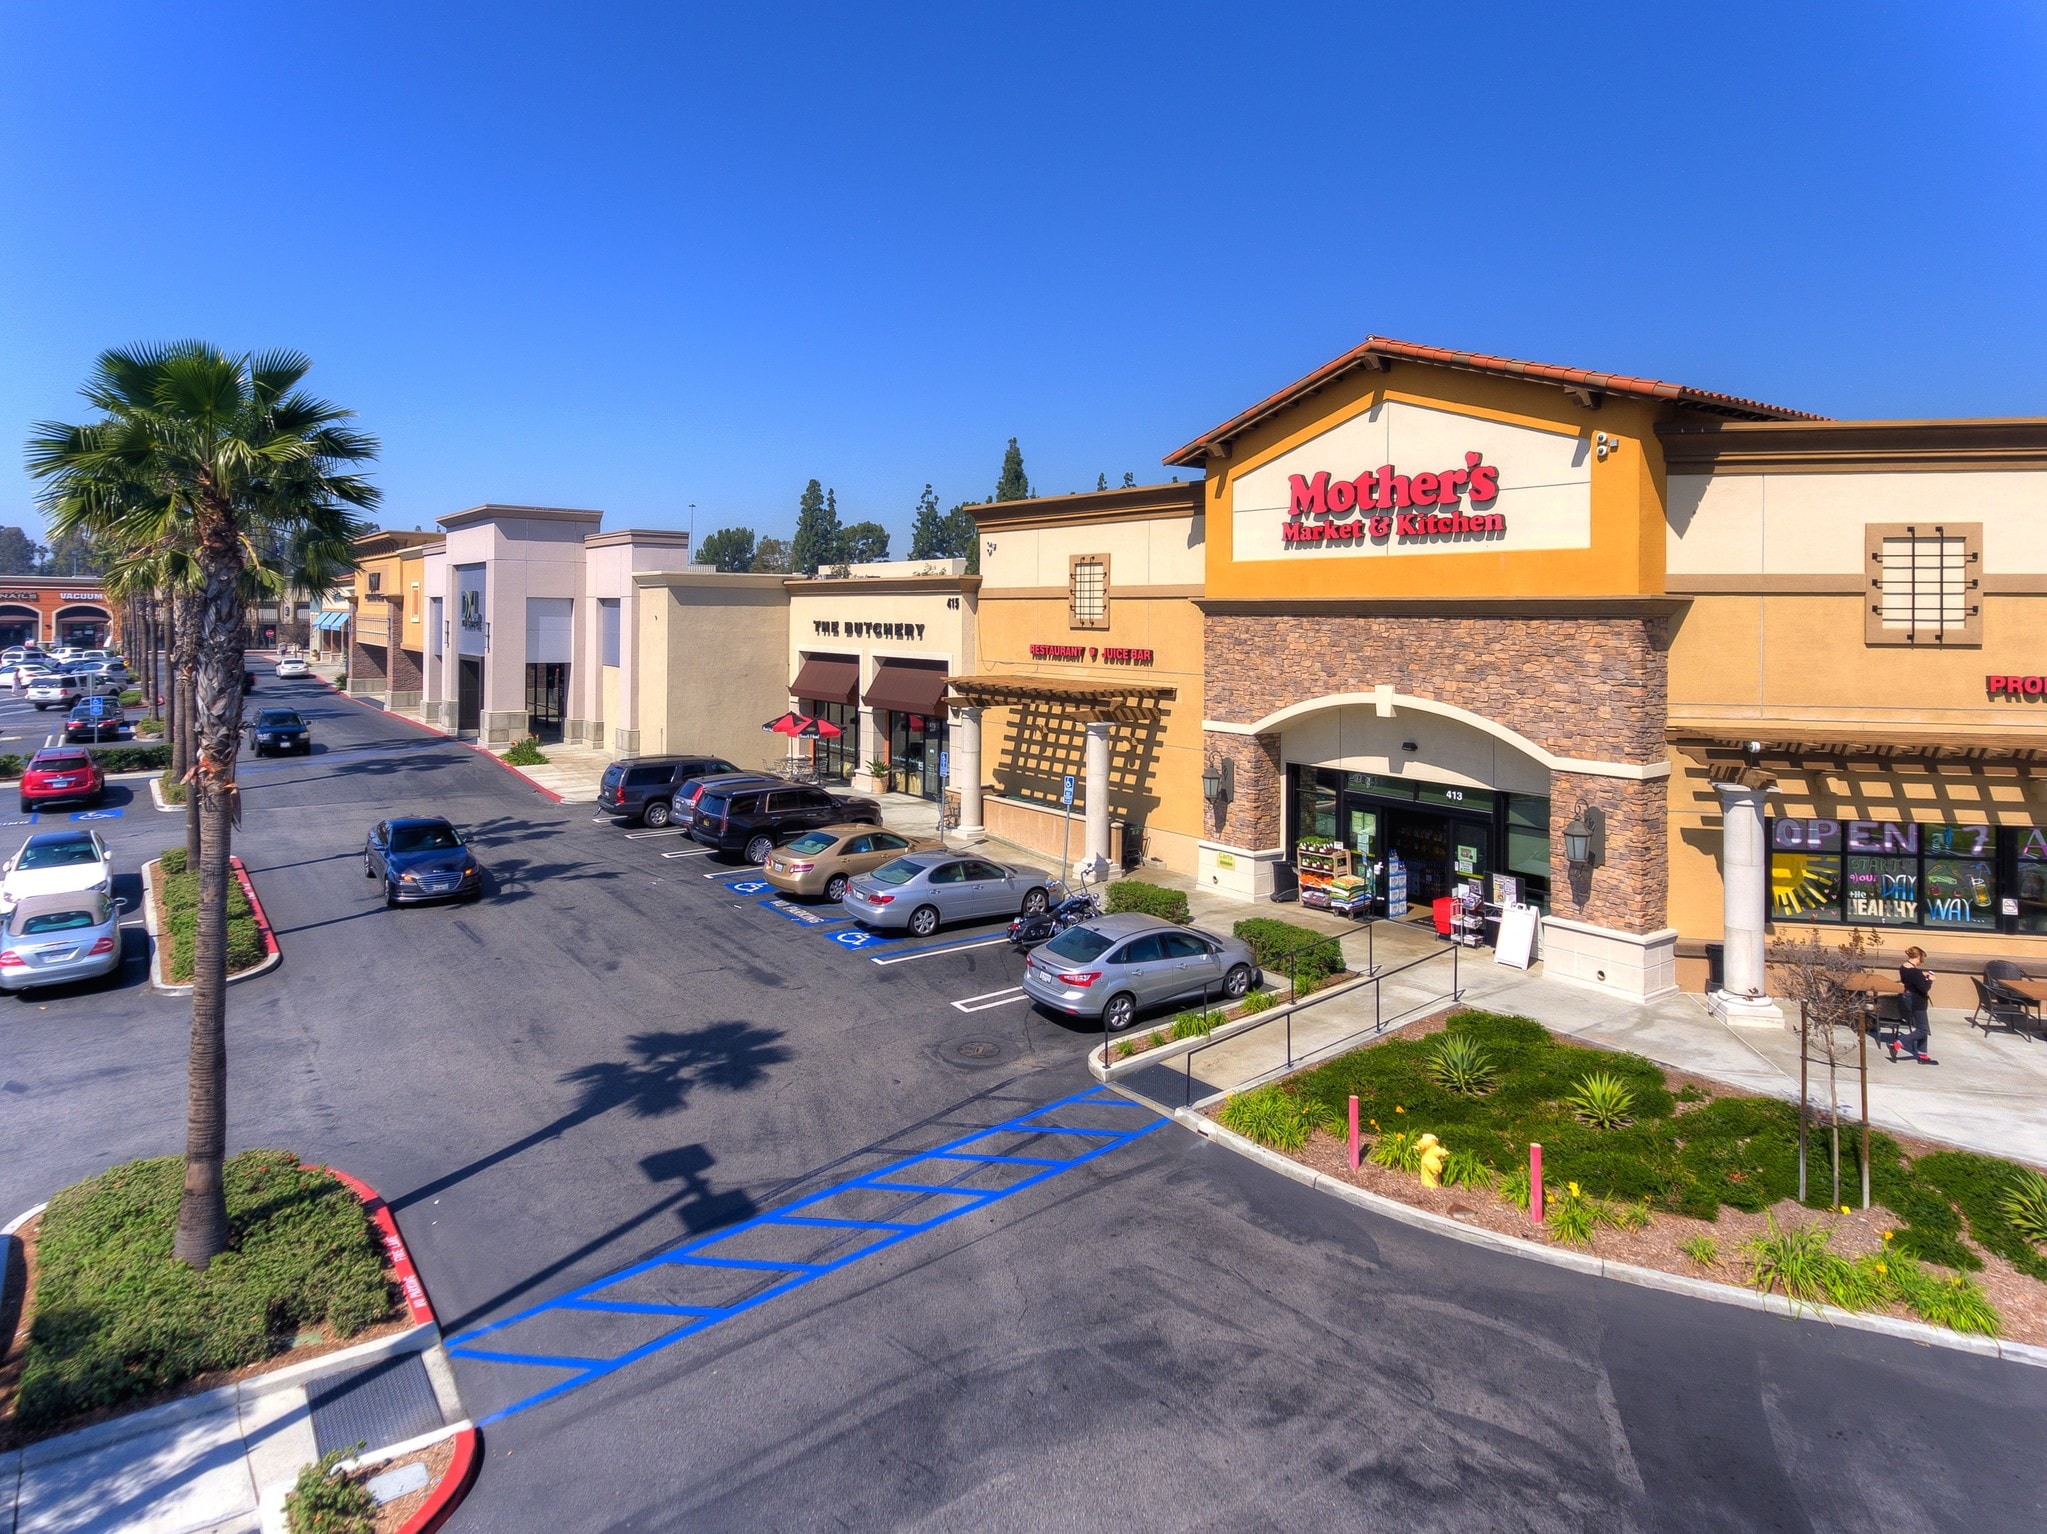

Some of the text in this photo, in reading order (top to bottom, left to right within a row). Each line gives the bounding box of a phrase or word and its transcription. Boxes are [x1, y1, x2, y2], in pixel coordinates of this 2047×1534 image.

[1288, 451, 1497, 515] Mother's
[1282, 511, 1504, 541] Market & Kitchen
[60, 592, 104, 600] VACUUM
[947, 598, 959, 609] 415
[813, 620, 925, 640] THE BUTCHERY
[1030, 645, 1151, 661] RESTAURANT JUICE BAR
[1988, 675, 2047, 694] PRO
[1446, 790, 1462, 800] 413
[1774, 818, 1918, 853] OPEN
[1962, 825, 1990, 856] 7
[1851, 858, 1901, 872] START
[1881, 874, 1917, 900] DAY
